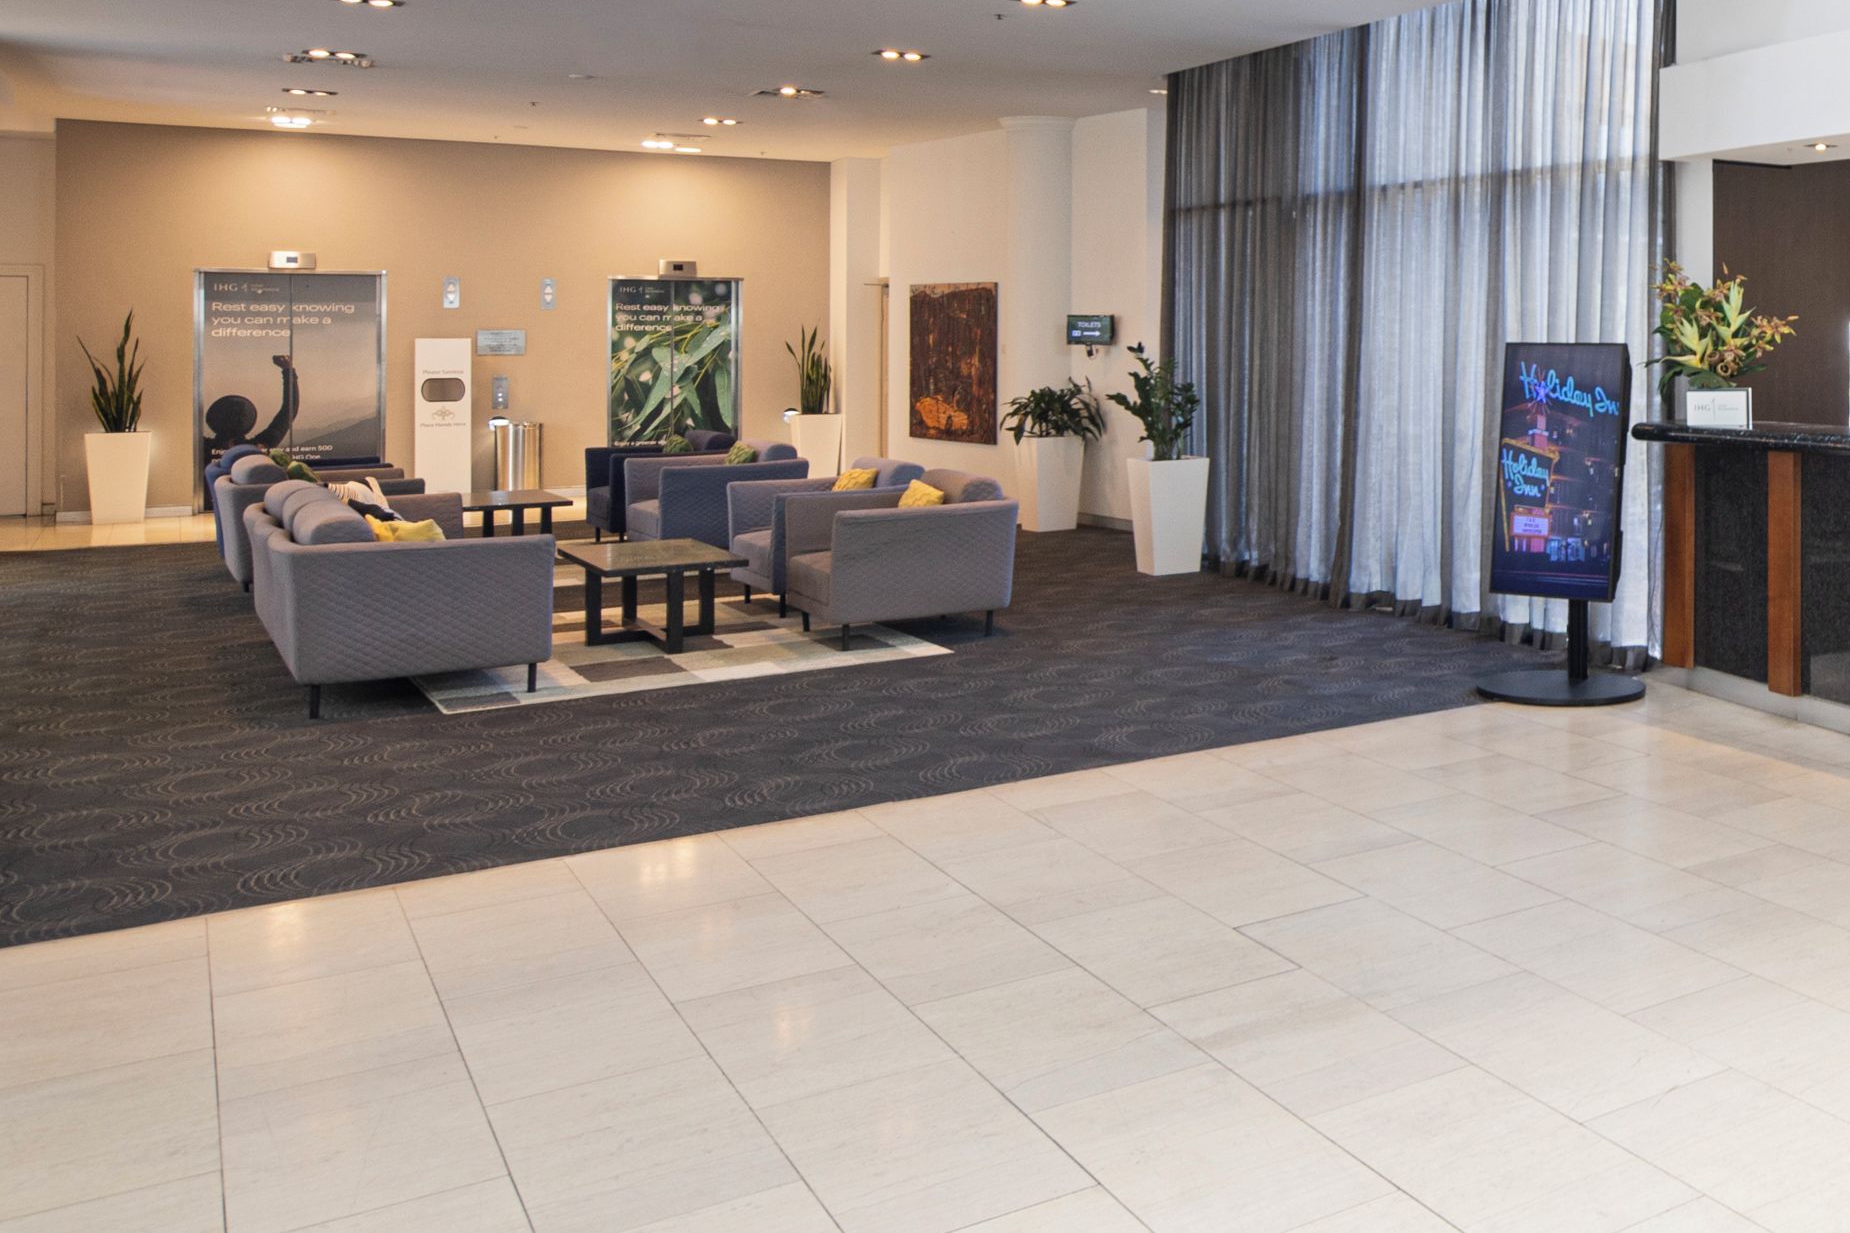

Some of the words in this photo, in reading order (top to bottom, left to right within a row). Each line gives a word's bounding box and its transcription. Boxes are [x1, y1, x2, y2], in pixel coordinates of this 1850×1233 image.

[213, 283, 239, 292] IHG
[212, 301, 247, 312] Rest
[249, 304, 286, 314] easy
[616, 302, 641, 312] Rest
[643, 304, 669, 313] easy
[211, 317, 241, 326] you
[244, 316, 274, 325] can
[322, 316, 332, 325] a
[615, 315, 637, 323] you
[638, 314, 660, 322] can
[211, 327, 292, 338] difference
[615, 323, 673, 333] difference
[1520, 361, 1594, 418] Hliday
[318, 443, 333, 451] 500
[1501, 448, 1549, 487] Holiday
[1513, 474, 1541, 497] Inn
